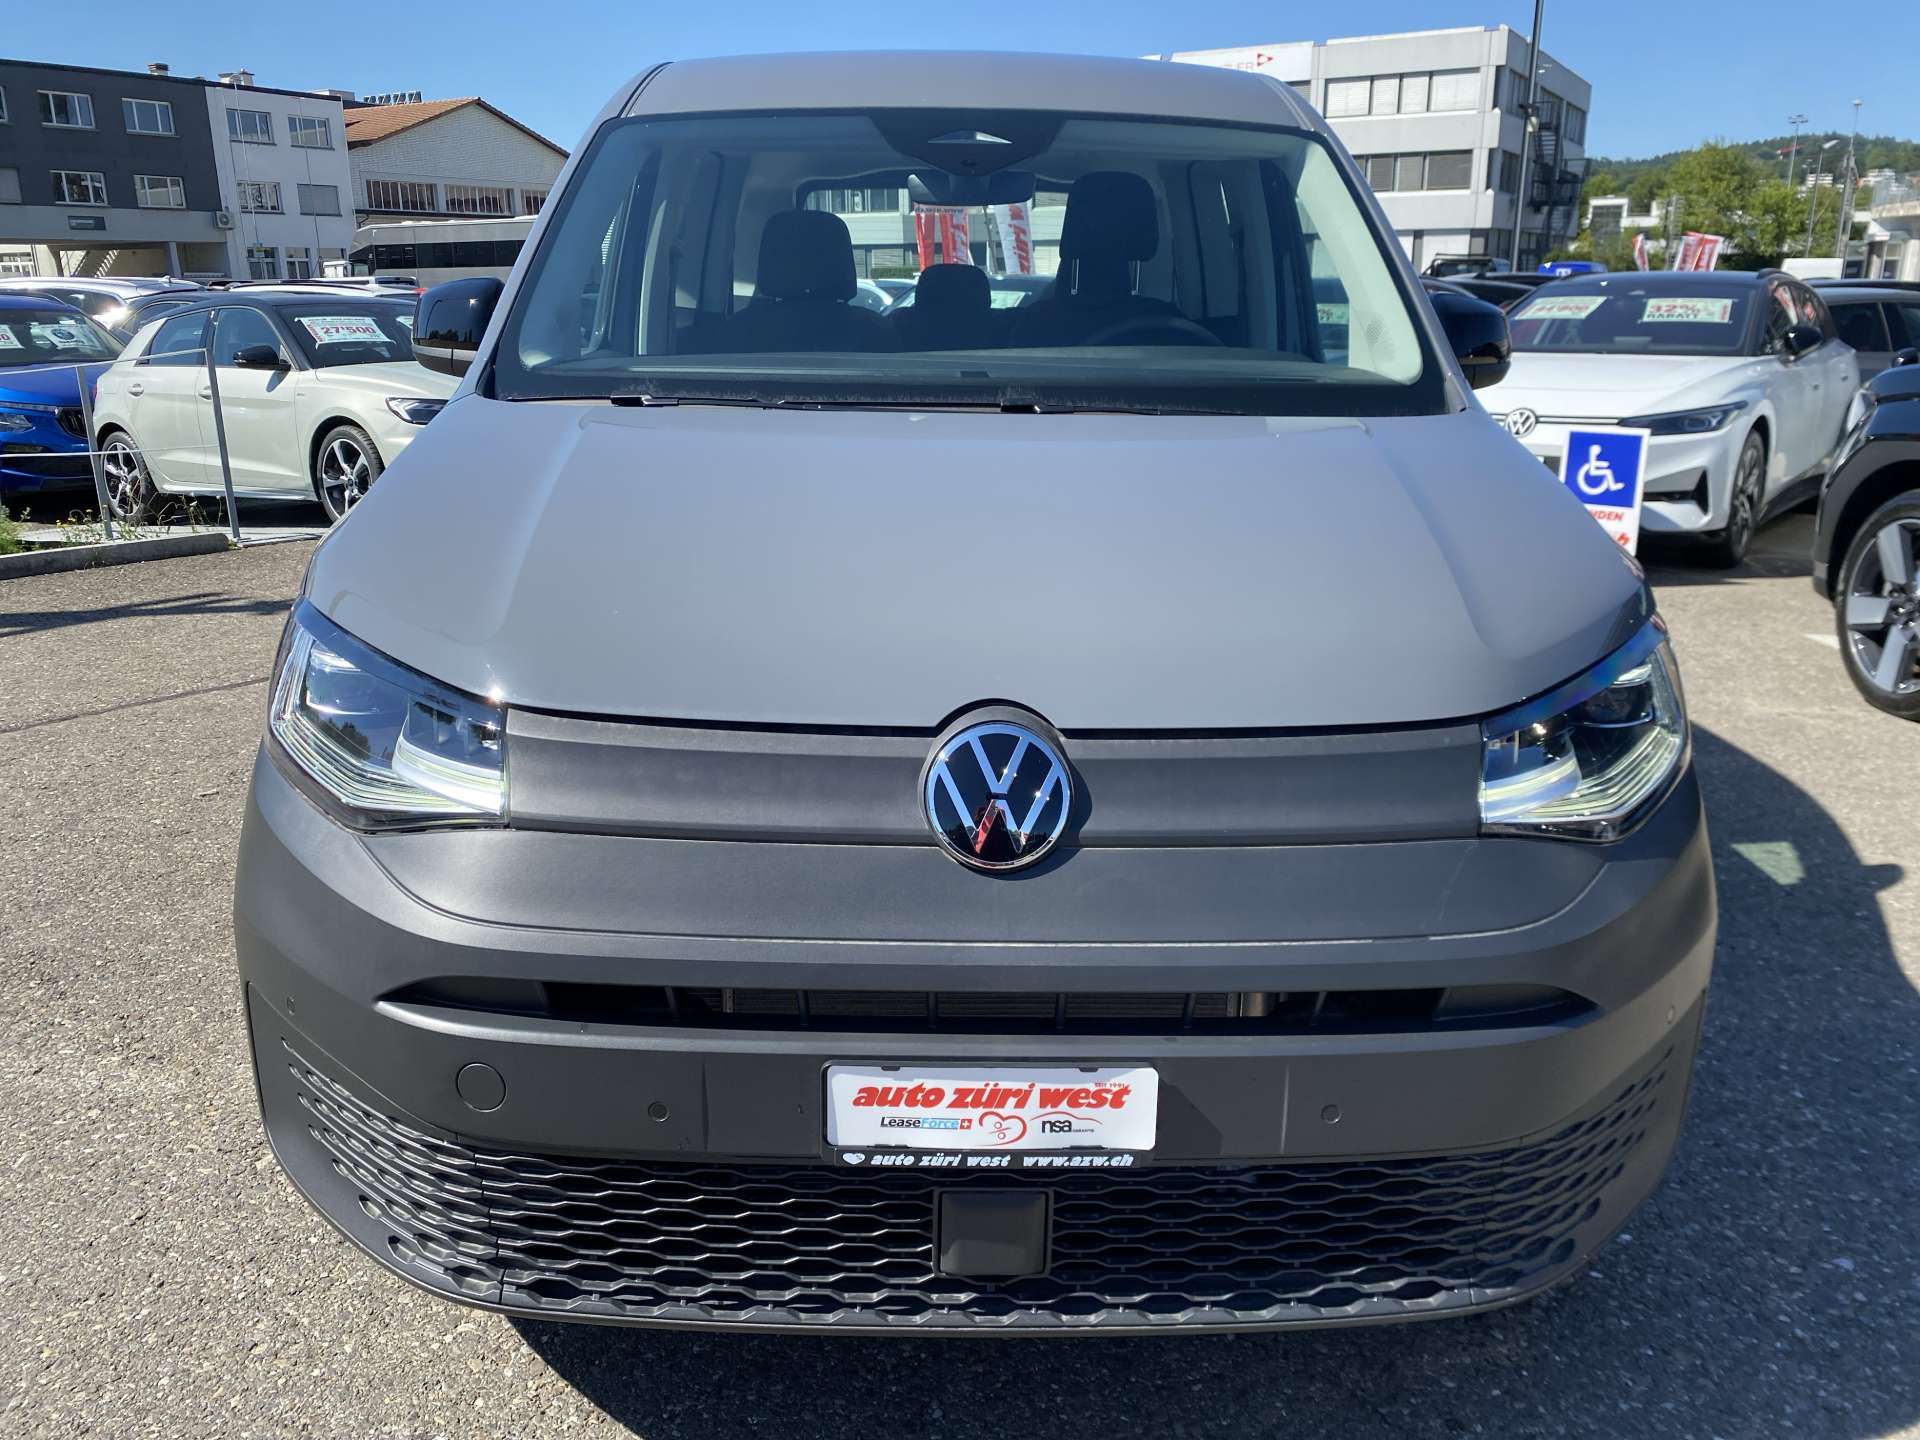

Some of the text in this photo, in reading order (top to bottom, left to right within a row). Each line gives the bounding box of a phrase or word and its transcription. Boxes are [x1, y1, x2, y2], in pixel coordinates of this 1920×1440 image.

[321, 325, 377, 335] 27'500
[852, 1082, 1132, 1109] auto züri west
[880, 1116, 959, 1129] LeaseForce
[1041, 1119, 1072, 1133] nsa
[870, 1152, 1135, 1167] auto züri west www.azw.ch
